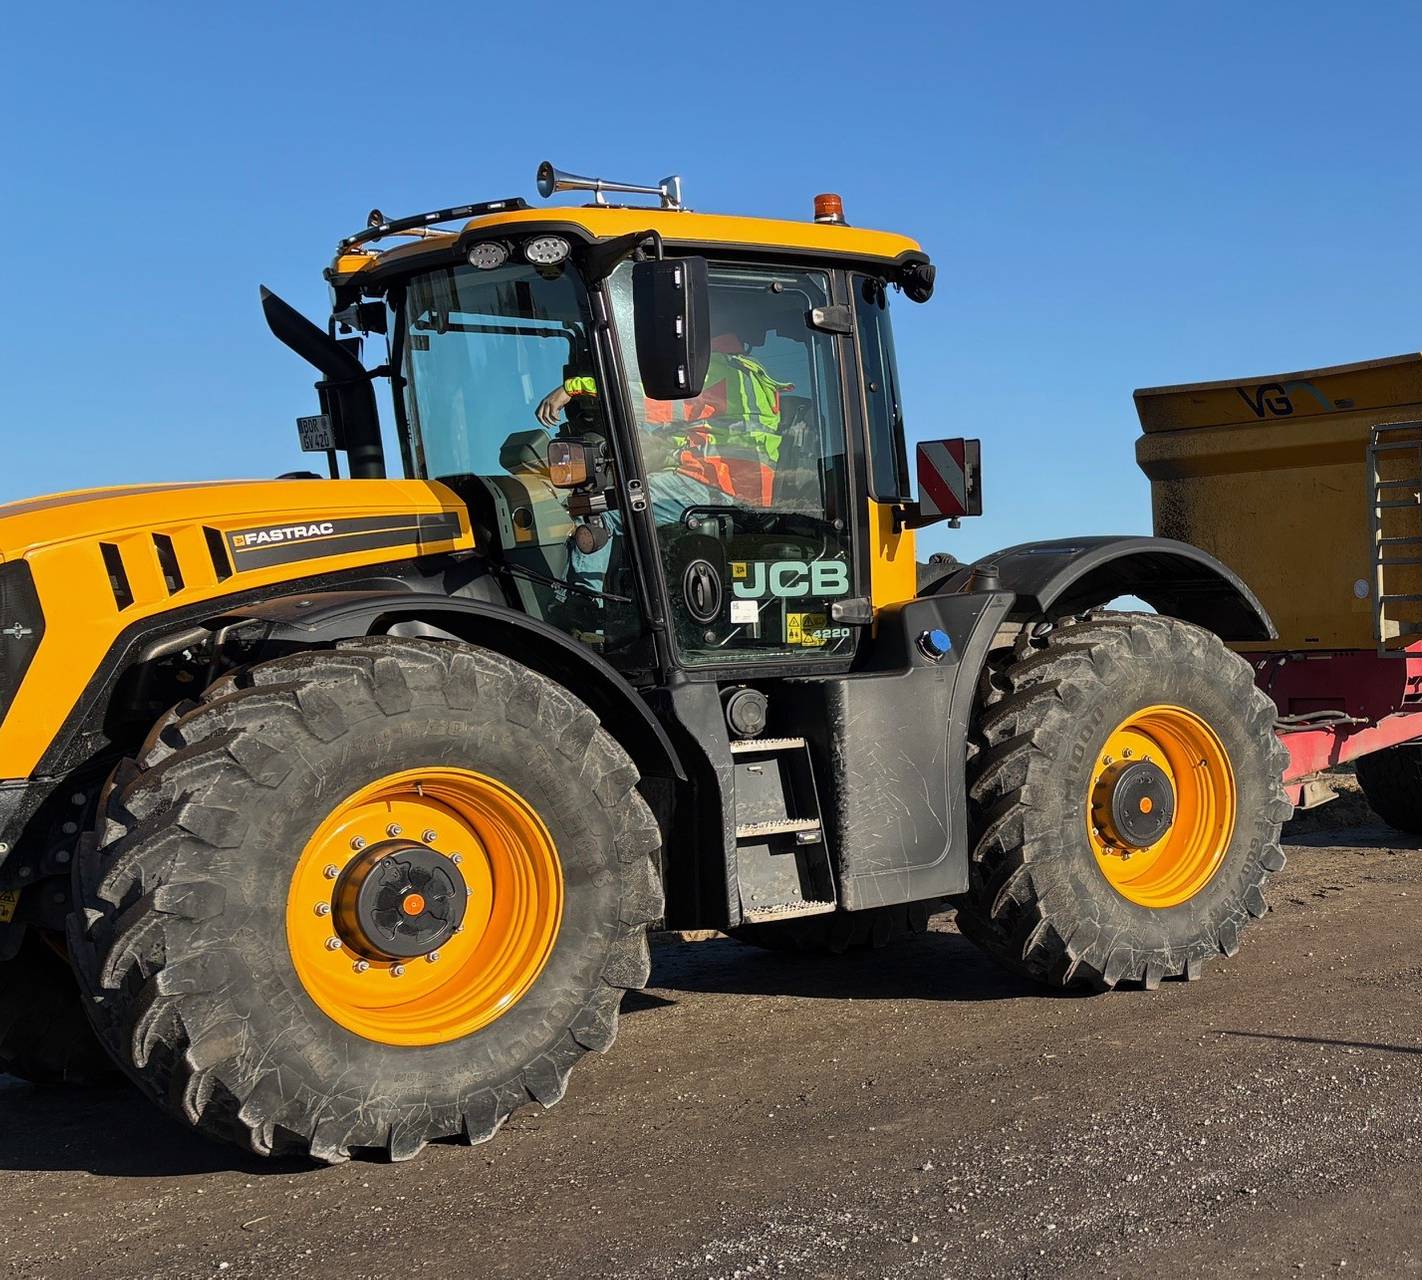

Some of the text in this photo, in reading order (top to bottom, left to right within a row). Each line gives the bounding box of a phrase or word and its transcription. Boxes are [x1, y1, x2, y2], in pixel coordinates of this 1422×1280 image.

[244, 522, 335, 545] FASTRAC
[733, 561, 849, 598] JCB
[813, 627, 851, 639] 4220
